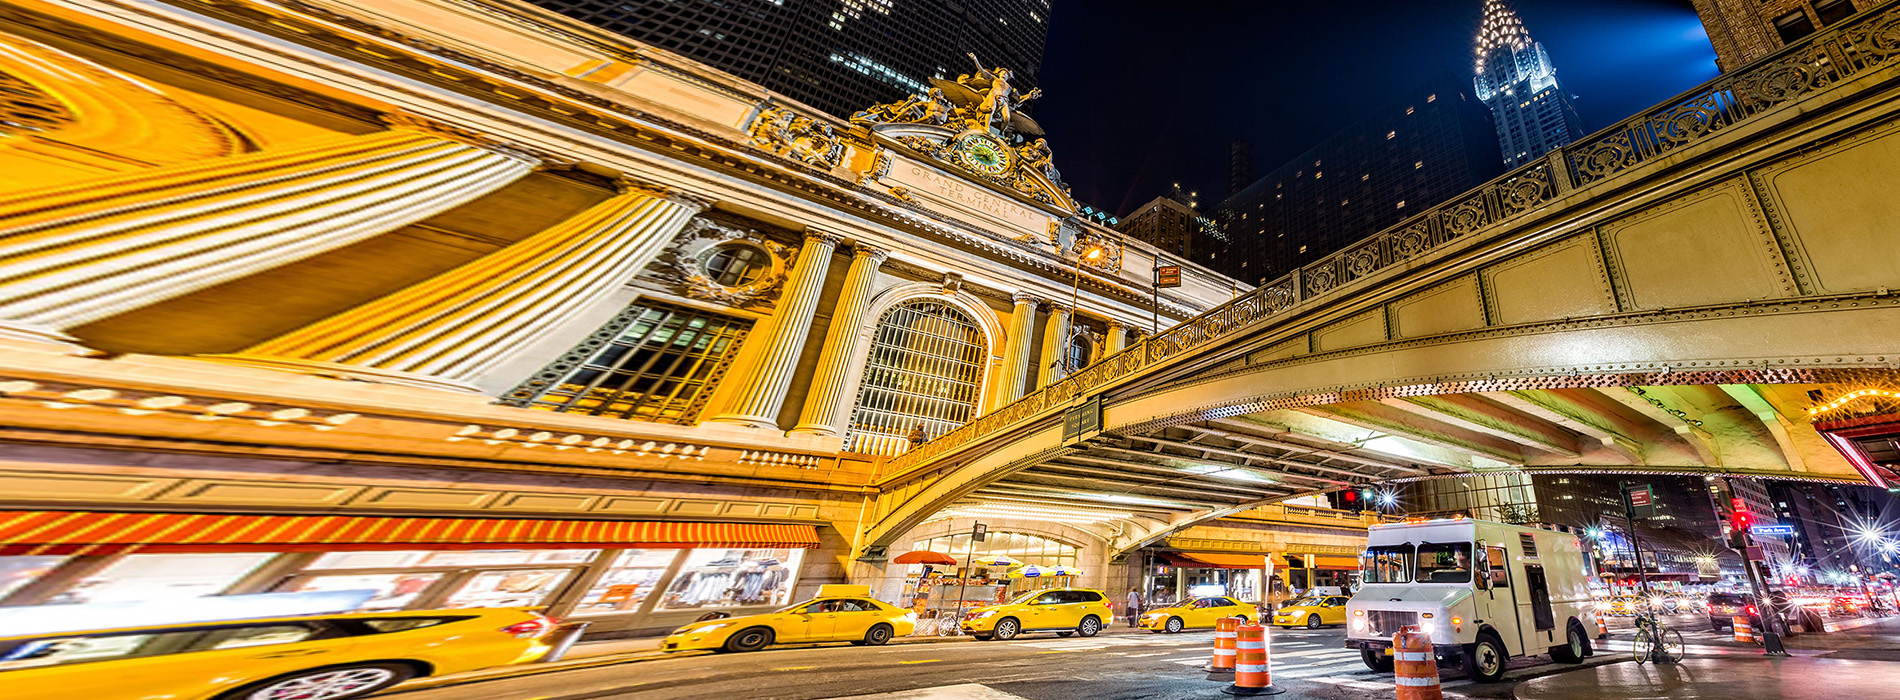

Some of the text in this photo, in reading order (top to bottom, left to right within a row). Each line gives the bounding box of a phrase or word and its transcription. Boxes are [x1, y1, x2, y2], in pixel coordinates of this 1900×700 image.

[911, 167, 1035, 220] GRAND CENTRAL
[939, 186, 1010, 218] TERMINAL
